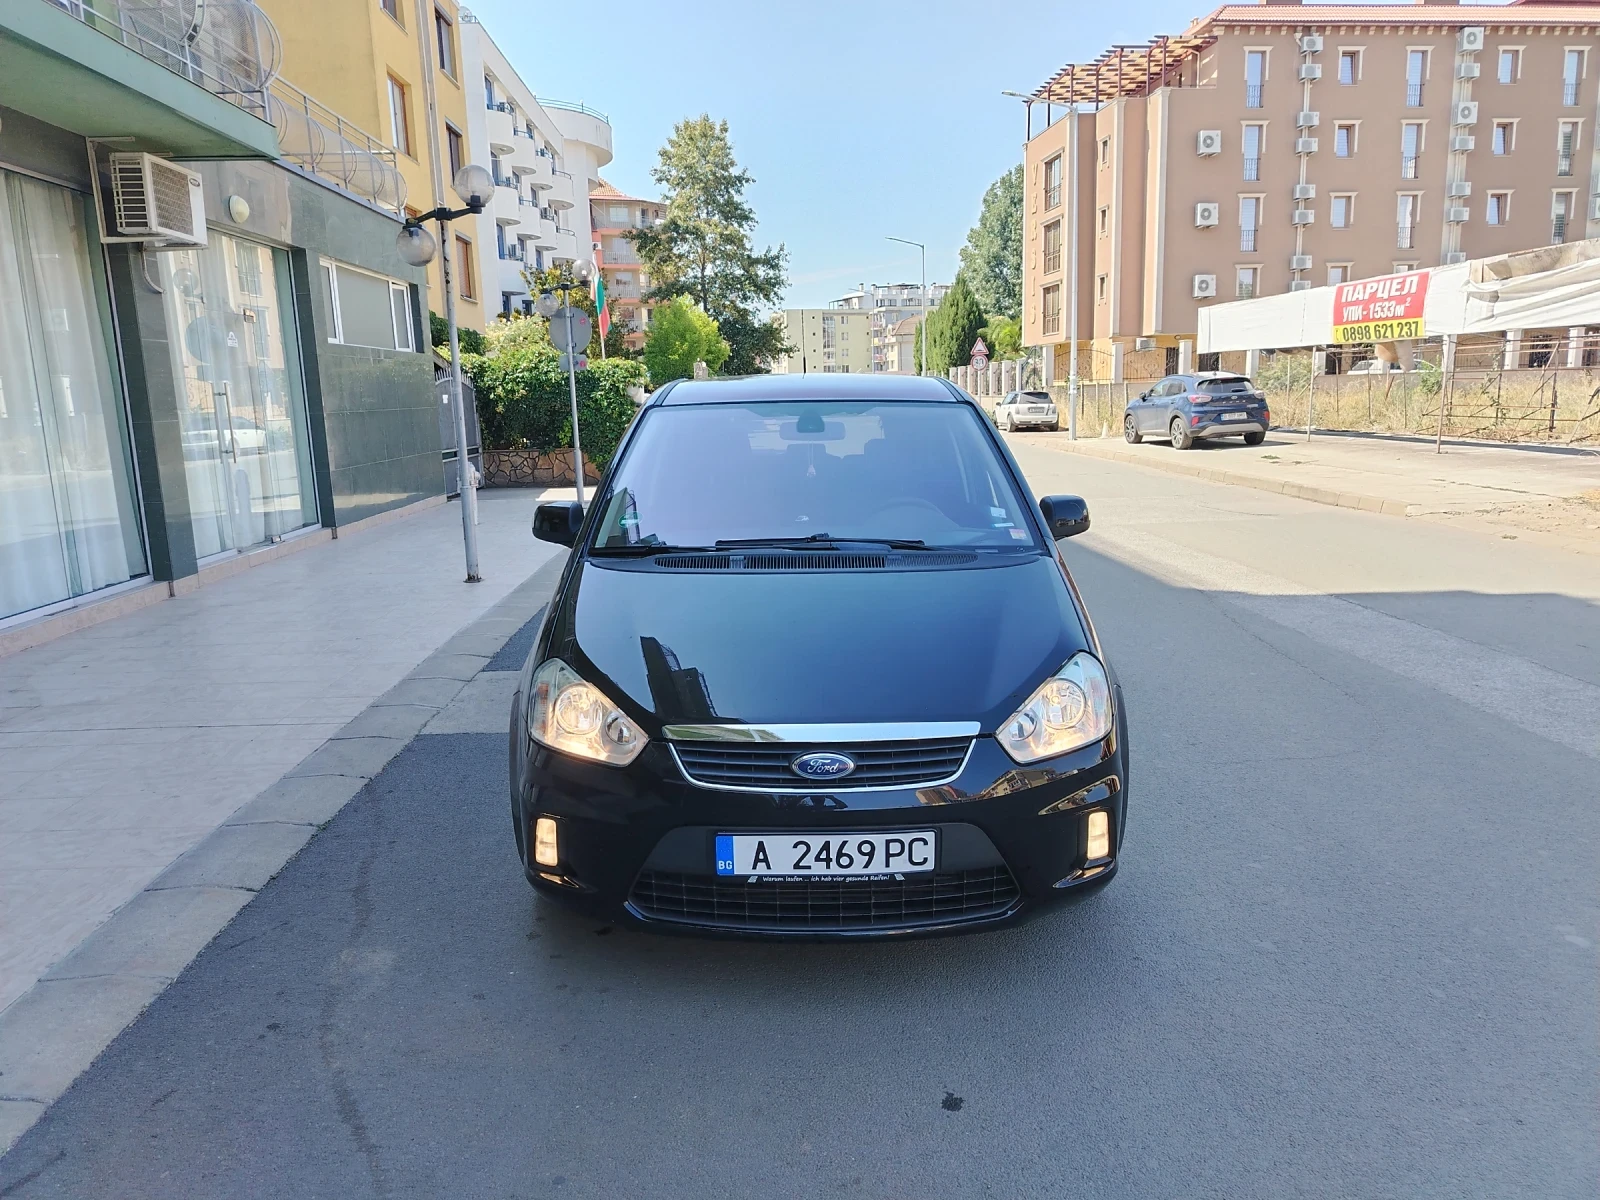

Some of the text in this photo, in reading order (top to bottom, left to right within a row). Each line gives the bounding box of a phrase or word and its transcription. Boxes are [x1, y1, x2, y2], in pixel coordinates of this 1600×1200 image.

[1341, 275, 1420, 303] ПАРЦЕЛ
[1342, 320, 1419, 342] 0898 621 237
[807, 758, 839, 773] Ford
[751, 837, 929, 870] A 2469 PC
[718, 860, 733, 870] BG
